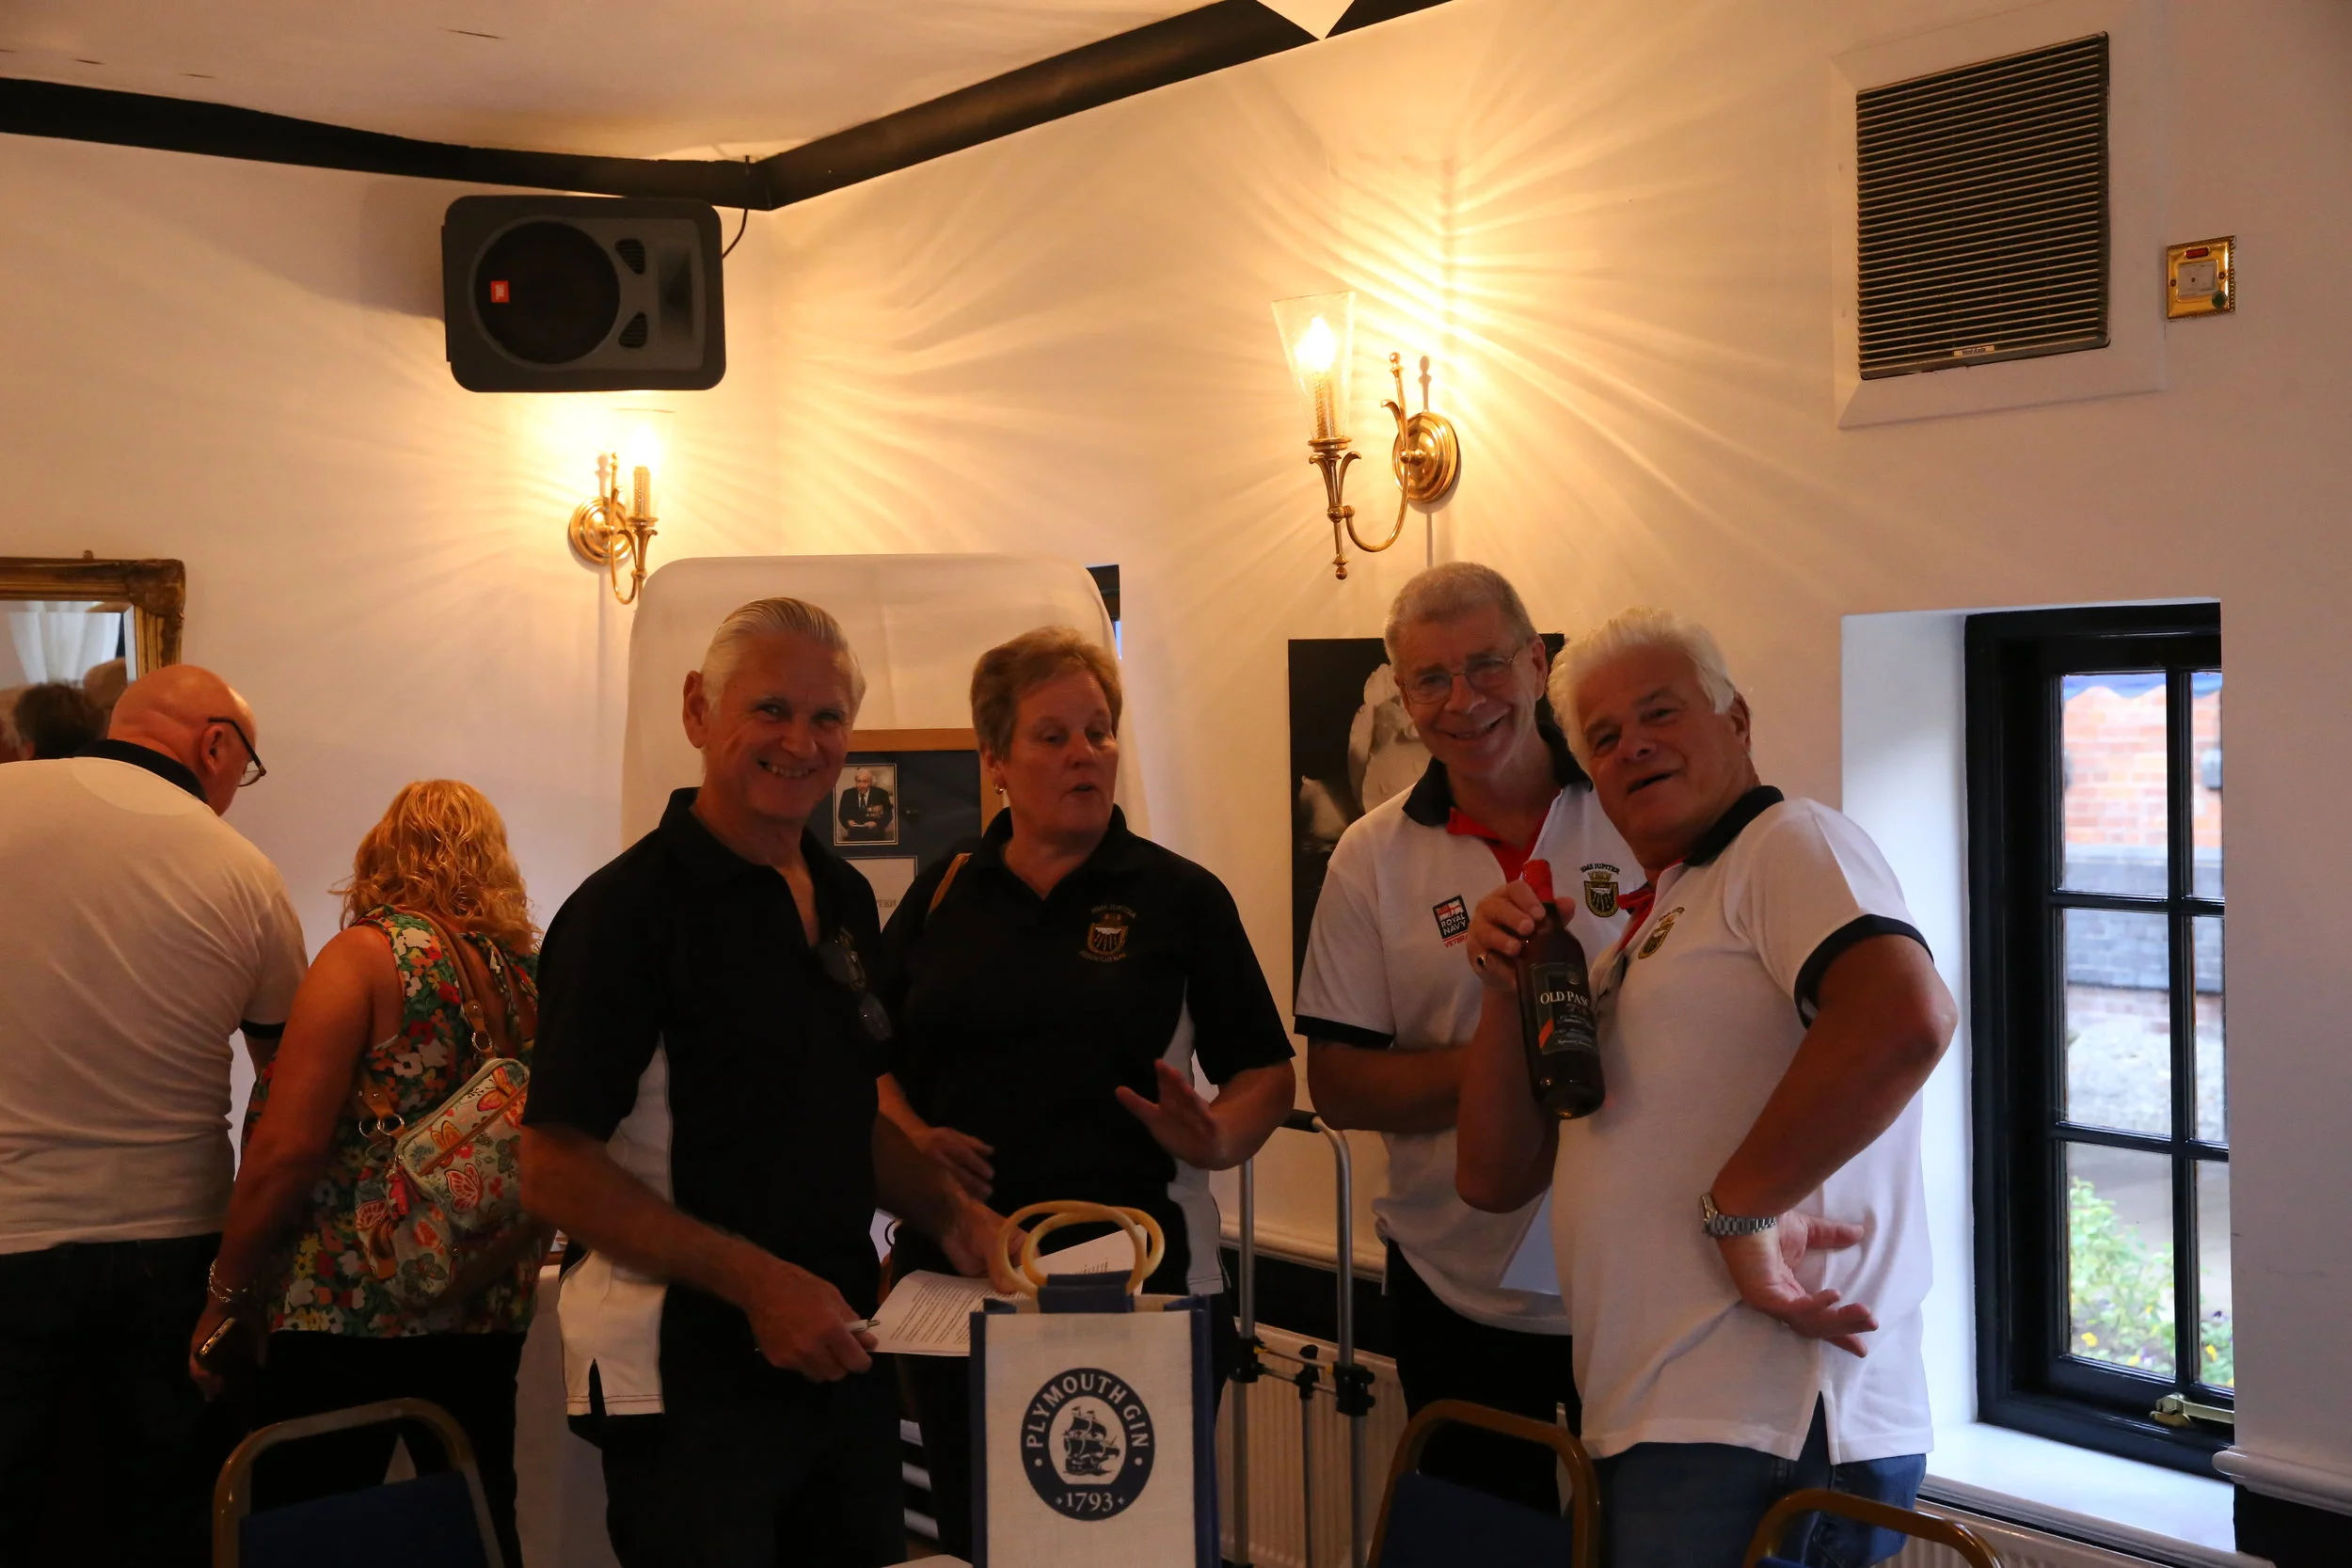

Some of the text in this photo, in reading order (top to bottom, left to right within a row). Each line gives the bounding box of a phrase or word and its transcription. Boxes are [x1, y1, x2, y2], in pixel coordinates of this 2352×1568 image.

[1581, 863, 1620, 875] HMS JUPITER
[1440, 912, 1466, 928] ROYAL
[1442, 920, 1467, 936] NAVY
[1540, 990, 1565, 1005] OLD
[1026, 1373, 1150, 1449] PLYMOUTH GIN
[1065, 1492, 1114, 1513] 1793
